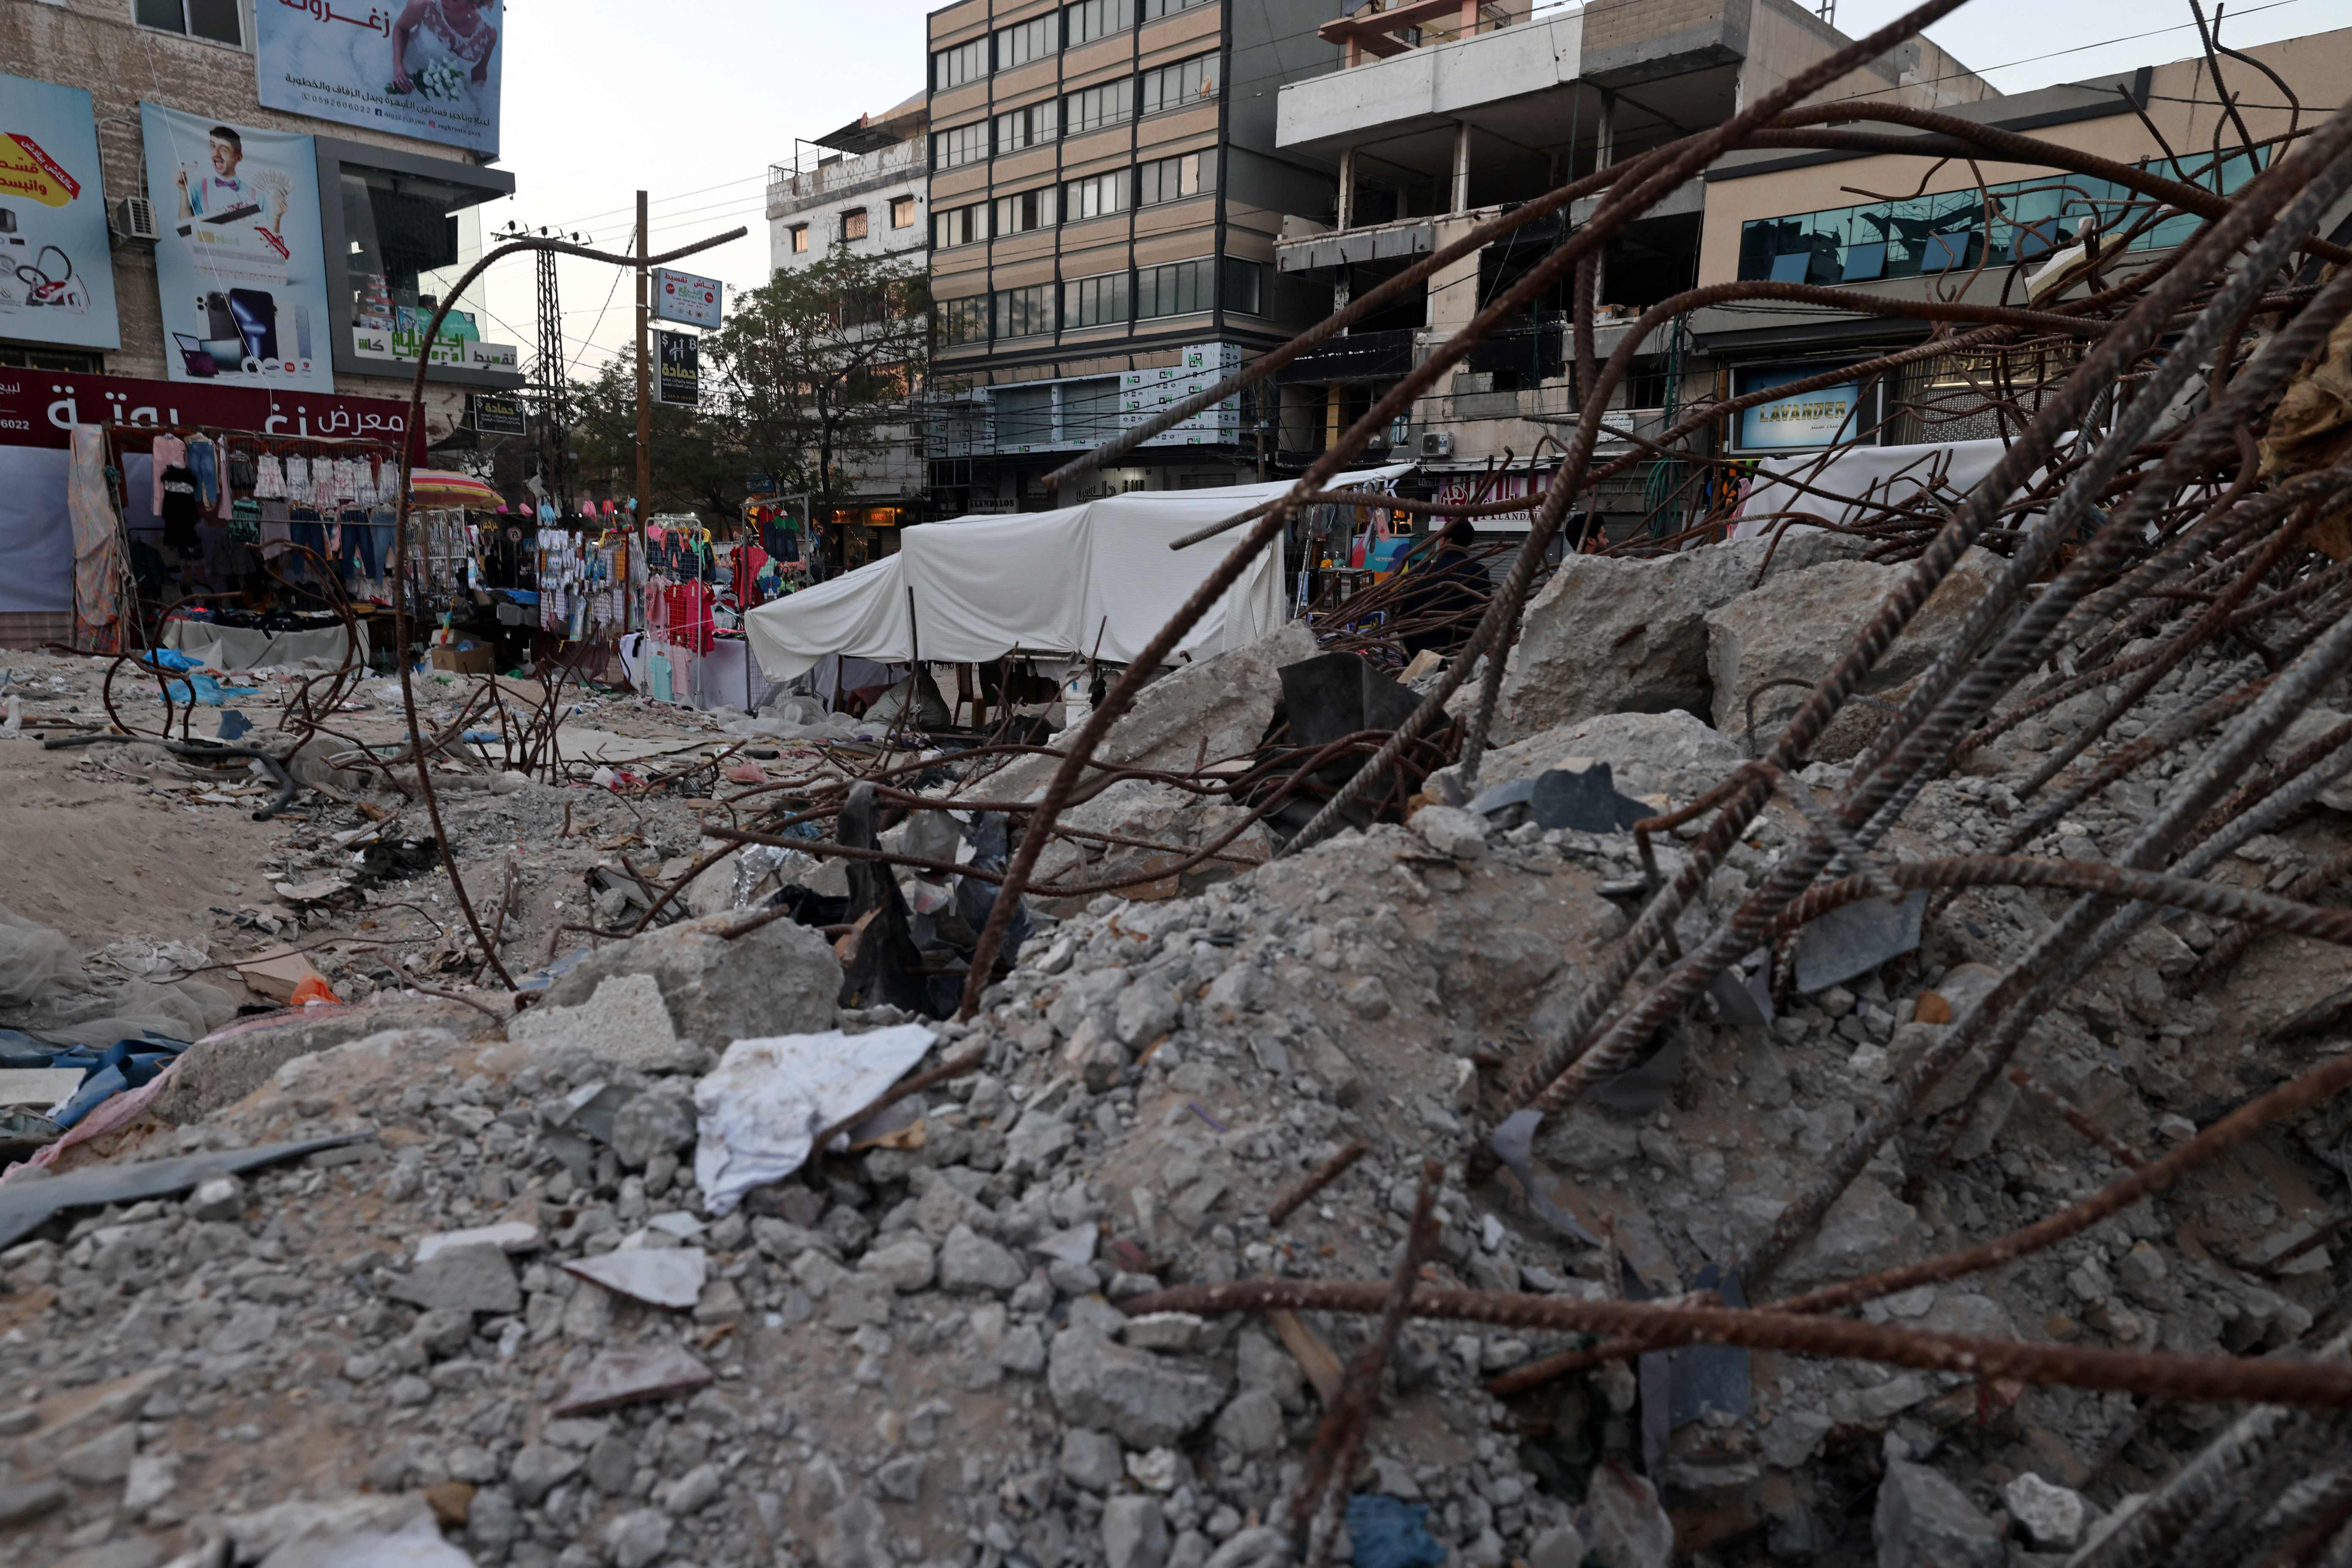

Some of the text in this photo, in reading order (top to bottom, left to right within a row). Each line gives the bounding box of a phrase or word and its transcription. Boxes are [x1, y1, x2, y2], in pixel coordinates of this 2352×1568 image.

[285, 73, 330, 93] والخطوبة
[332, 85, 360, 98] الزفاف
[358, 338, 384, 351] كاش
[473, 351, 516, 366] تقسيط
[662, 362, 697, 380] حمادة
[485, 402, 514, 415] حمادة
[1760, 400, 1846, 422] LAVANDER
[318, 404, 404, 436] معرض
